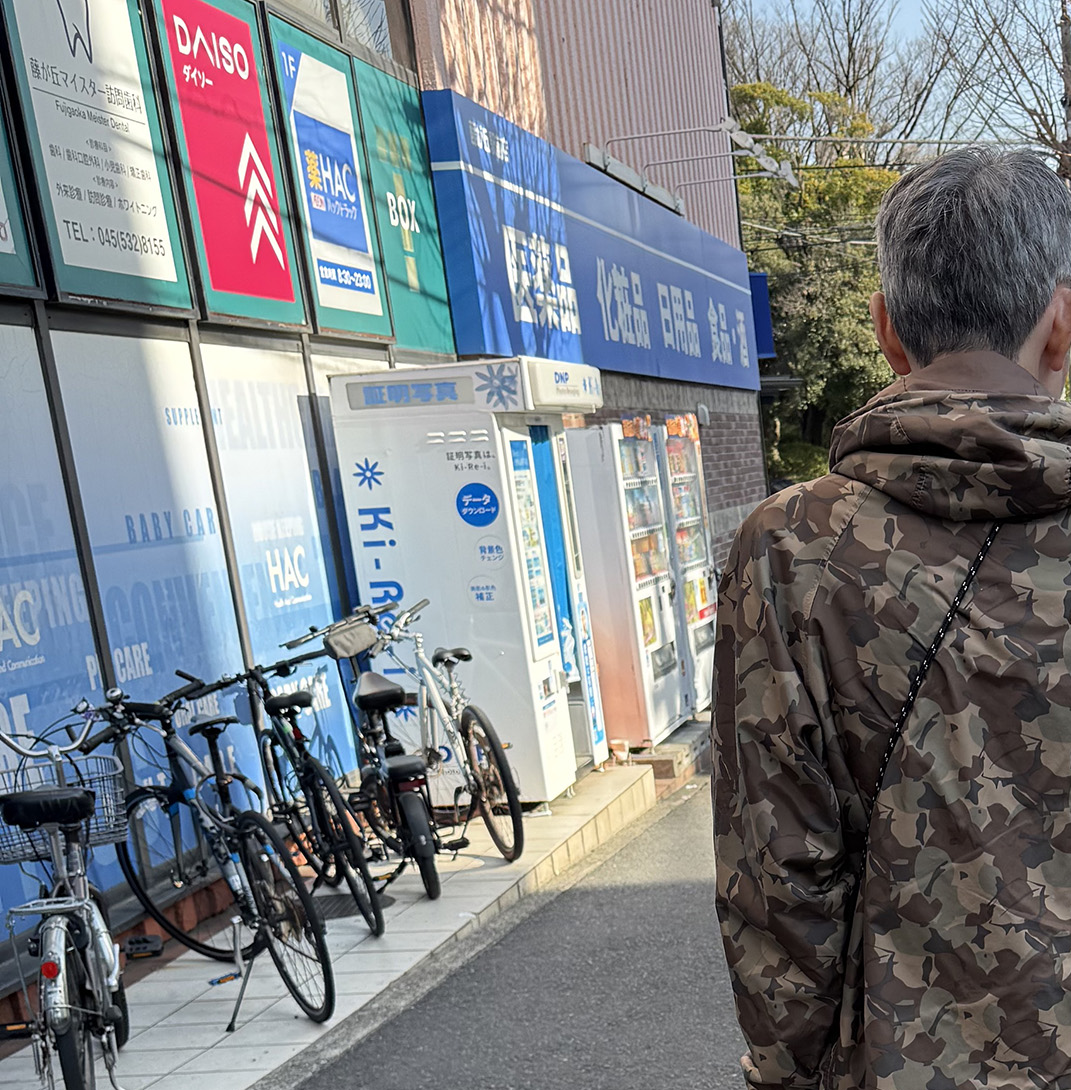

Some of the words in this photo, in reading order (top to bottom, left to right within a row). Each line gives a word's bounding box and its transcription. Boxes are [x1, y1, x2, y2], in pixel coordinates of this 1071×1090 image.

[173, 14, 249, 80] DAISO
[282, 51, 296, 79] 1F
[30, 57, 142, 114] 藤が丘マイスター訪問歯科
[183, 65, 213, 88] ダイソー
[319, 153, 356, 203] HAC
[386, 191, 420, 233] BOX
[502, 225, 582, 335] 医薬品
[597, 256, 651, 349] 化粧品
[657, 283, 702, 358] 日用品
[362, 381, 458, 405] 証明写真
[554, 371, 569, 384] DNP
[165, 407, 223, 426] SUPPLENT
[462, 493, 491, 506] データ
[125, 511, 174, 544] BABY
[266, 544, 309, 593] HAC
[114, 642, 153, 683] CARE
